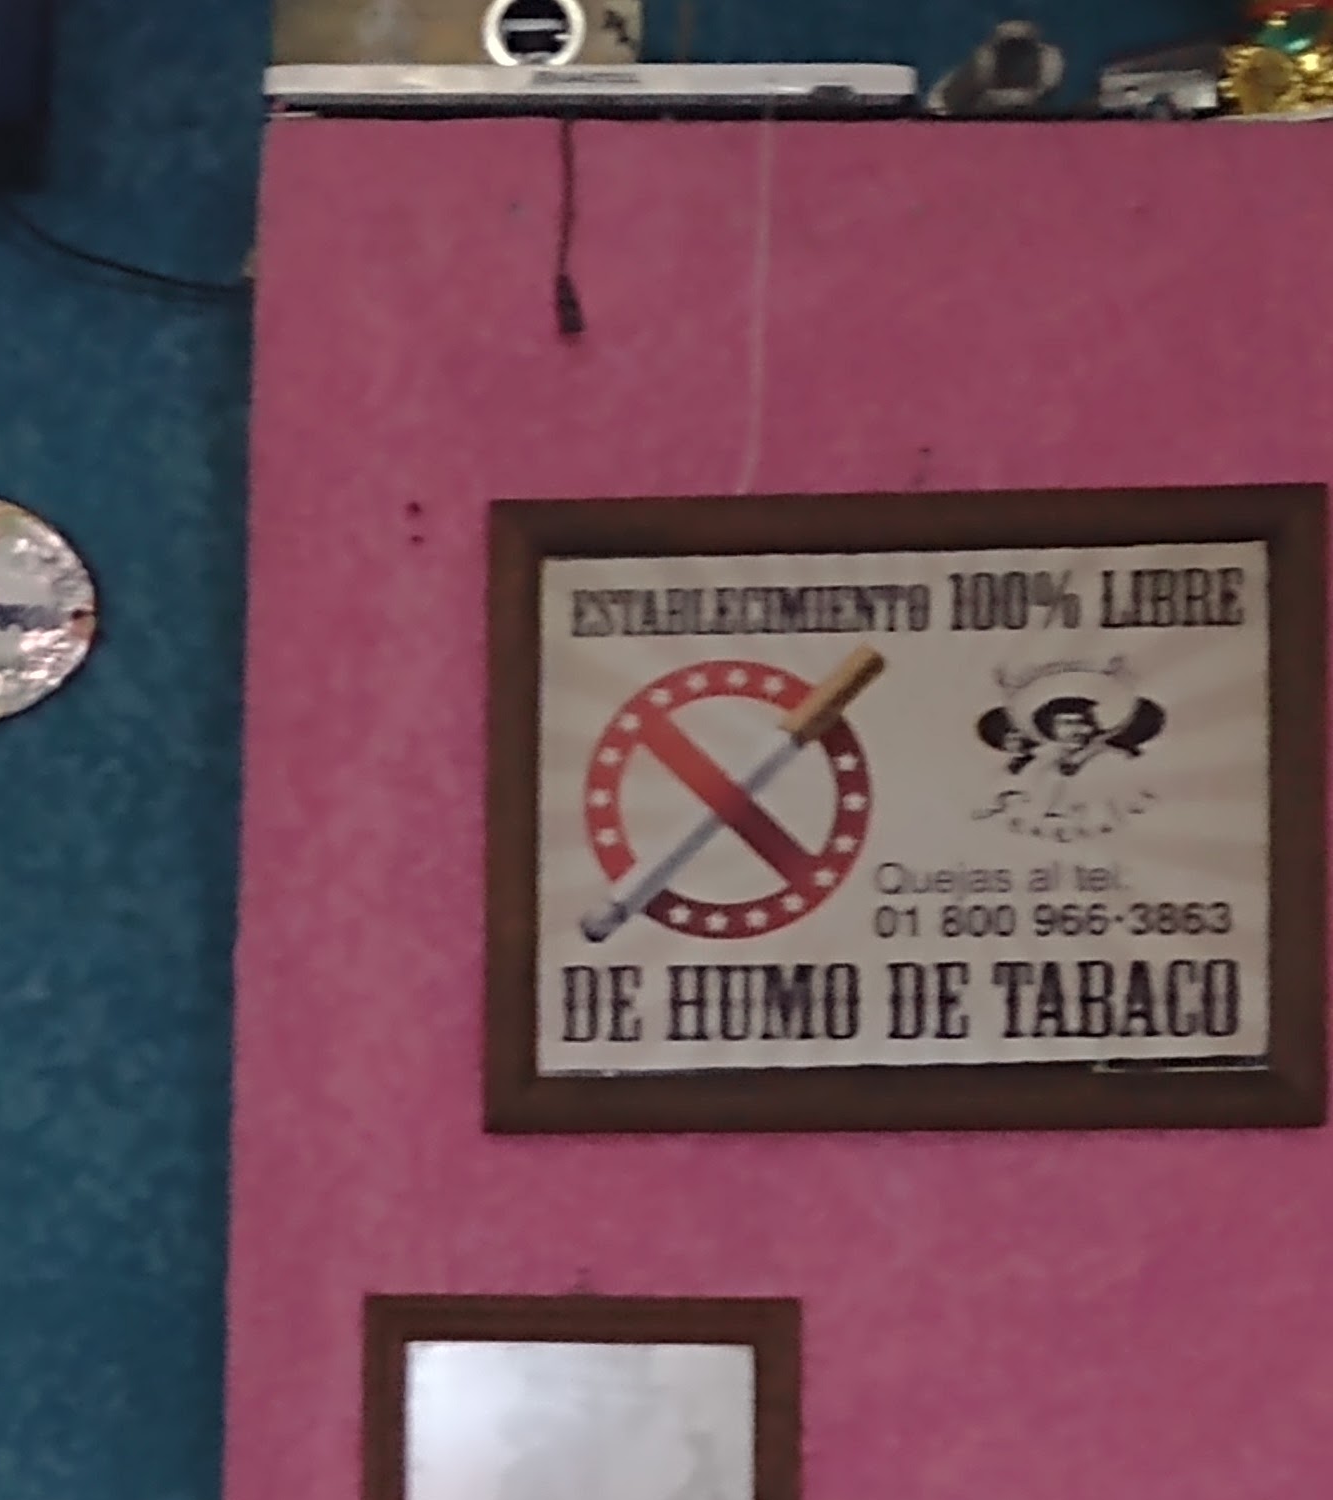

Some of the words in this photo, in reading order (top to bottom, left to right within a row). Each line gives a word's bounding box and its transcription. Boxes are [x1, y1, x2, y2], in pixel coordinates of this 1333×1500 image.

[570, 584, 930, 637] ESTABLECIMIENTO
[947, 569, 1080, 632] 100%
[1099, 567, 1246, 628] LIBRE
[875, 862, 1011, 901] Quejas
[1028, 860, 1058, 893] al
[874, 904, 920, 938] 01
[941, 904, 1016, 938] 800
[561, 963, 644, 1043] DE
[665, 963, 861, 1042] HUMO
[886, 962, 971, 1040] DE
[991, 958, 1240, 1039] TABACO
